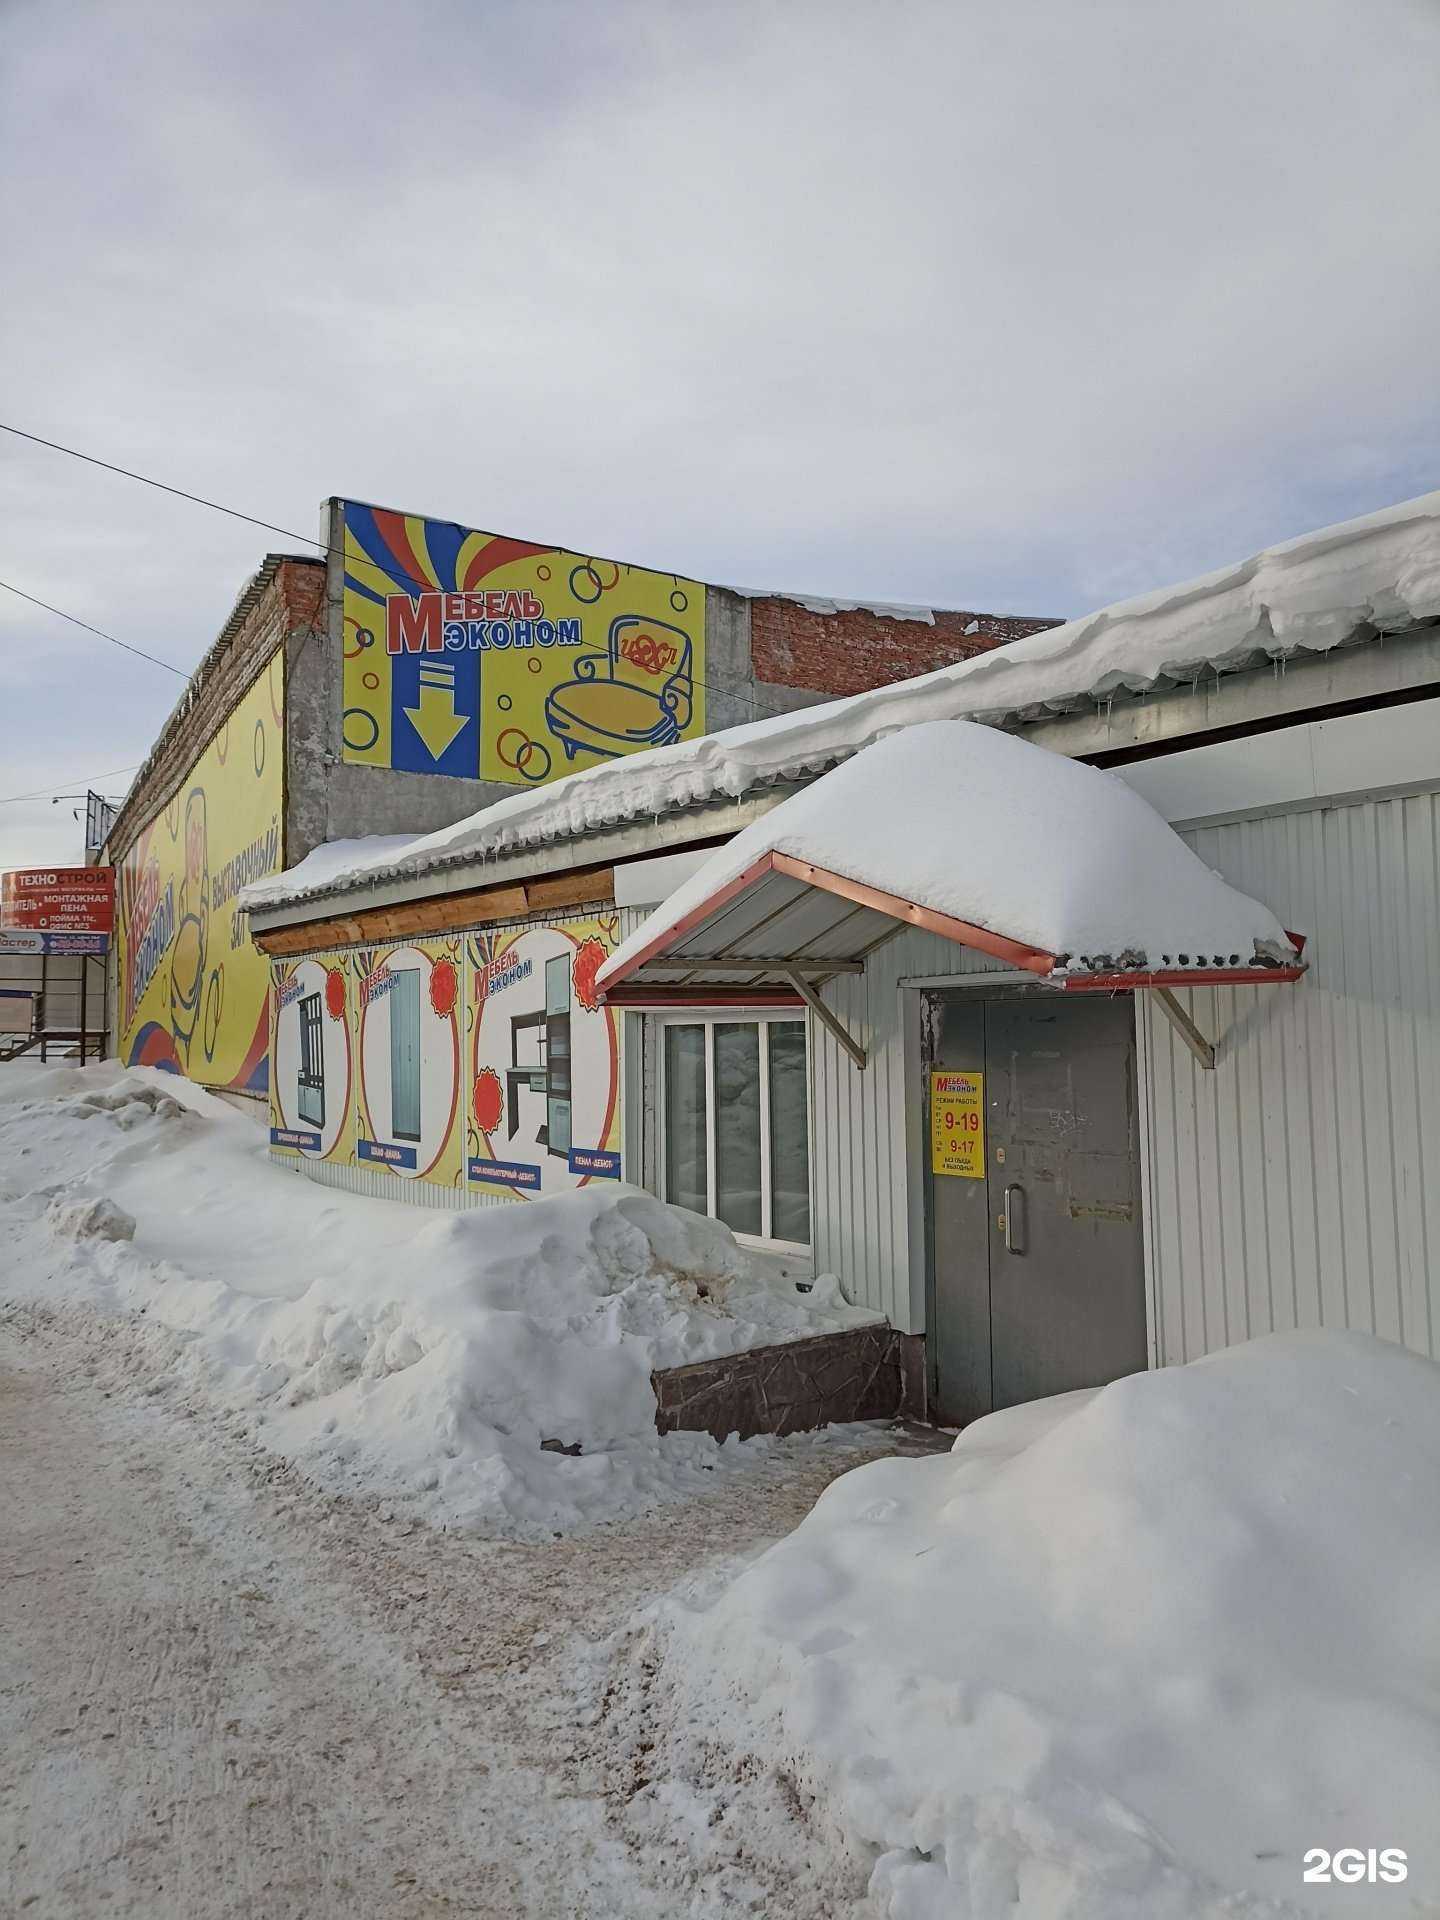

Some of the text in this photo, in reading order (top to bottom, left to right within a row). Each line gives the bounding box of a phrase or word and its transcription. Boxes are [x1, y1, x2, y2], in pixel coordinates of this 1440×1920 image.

[387, 591, 543, 654] МЕБЕЛЬ
[445, 618, 583, 650] ЭКОНОМ
[212, 813, 279, 911] ВЫСТАВОЧНЫЙ
[19, 872, 107, 886] ТЕХНОСТРОЙ
[44, 894, 109, 903] МОНТАЖНАЯ
[60, 904, 88, 912] ПЕНА
[368, 974, 400, 1001] ЭКОНОМ
[474, 949, 520, 1003] МЕБЕЛЬ
[489, 959, 533, 995] ЭКОНОМ
[945, 1111, 979, 1132] 9-19
[950, 1139, 975, 1153] 9-17
